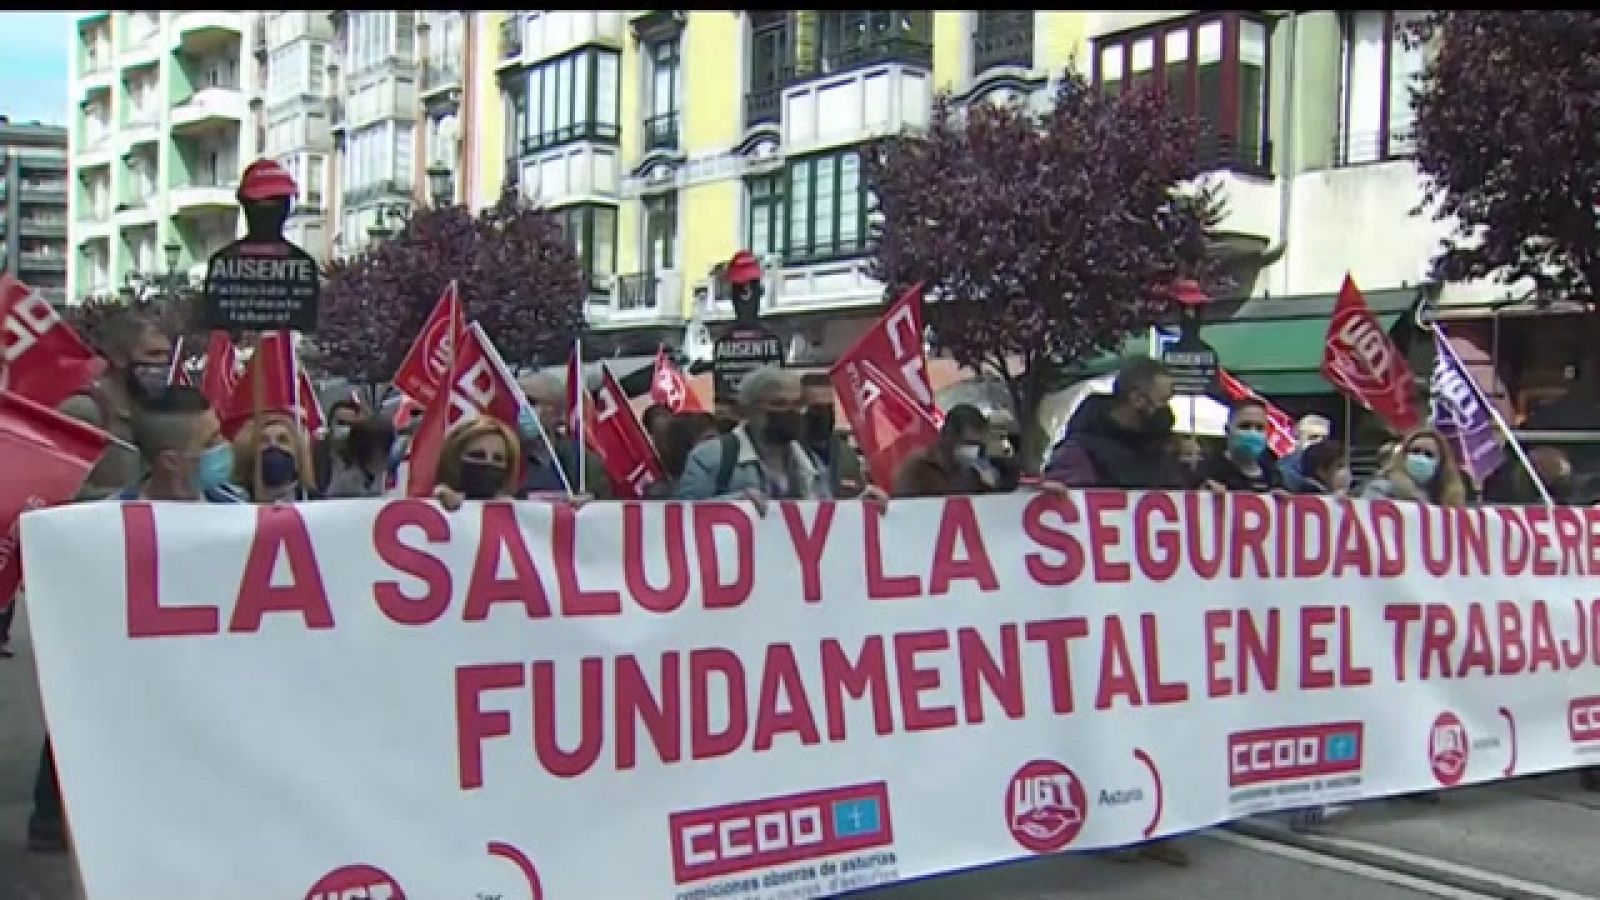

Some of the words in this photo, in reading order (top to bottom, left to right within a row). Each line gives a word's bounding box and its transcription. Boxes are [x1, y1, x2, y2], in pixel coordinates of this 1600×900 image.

[211, 257, 313, 280] AUSENTE
[121, 501, 335, 638] LA
[373, 500, 755, 625] SALUD
[779, 500, 837, 602] Y
[861, 496, 1000, 600] LA
[1022, 490, 1406, 586] SEGURIDAD
[1419, 501, 1492, 577] UN
[454, 613, 1189, 790] FUNDAMENTAL
[1204, 607, 1281, 698] EN
[1300, 605, 1373, 690] EL
[1232, 736, 1319, 775] CCOO
[1014, 774, 1074, 816] UGT
[682, 806, 824, 867] CCOO
